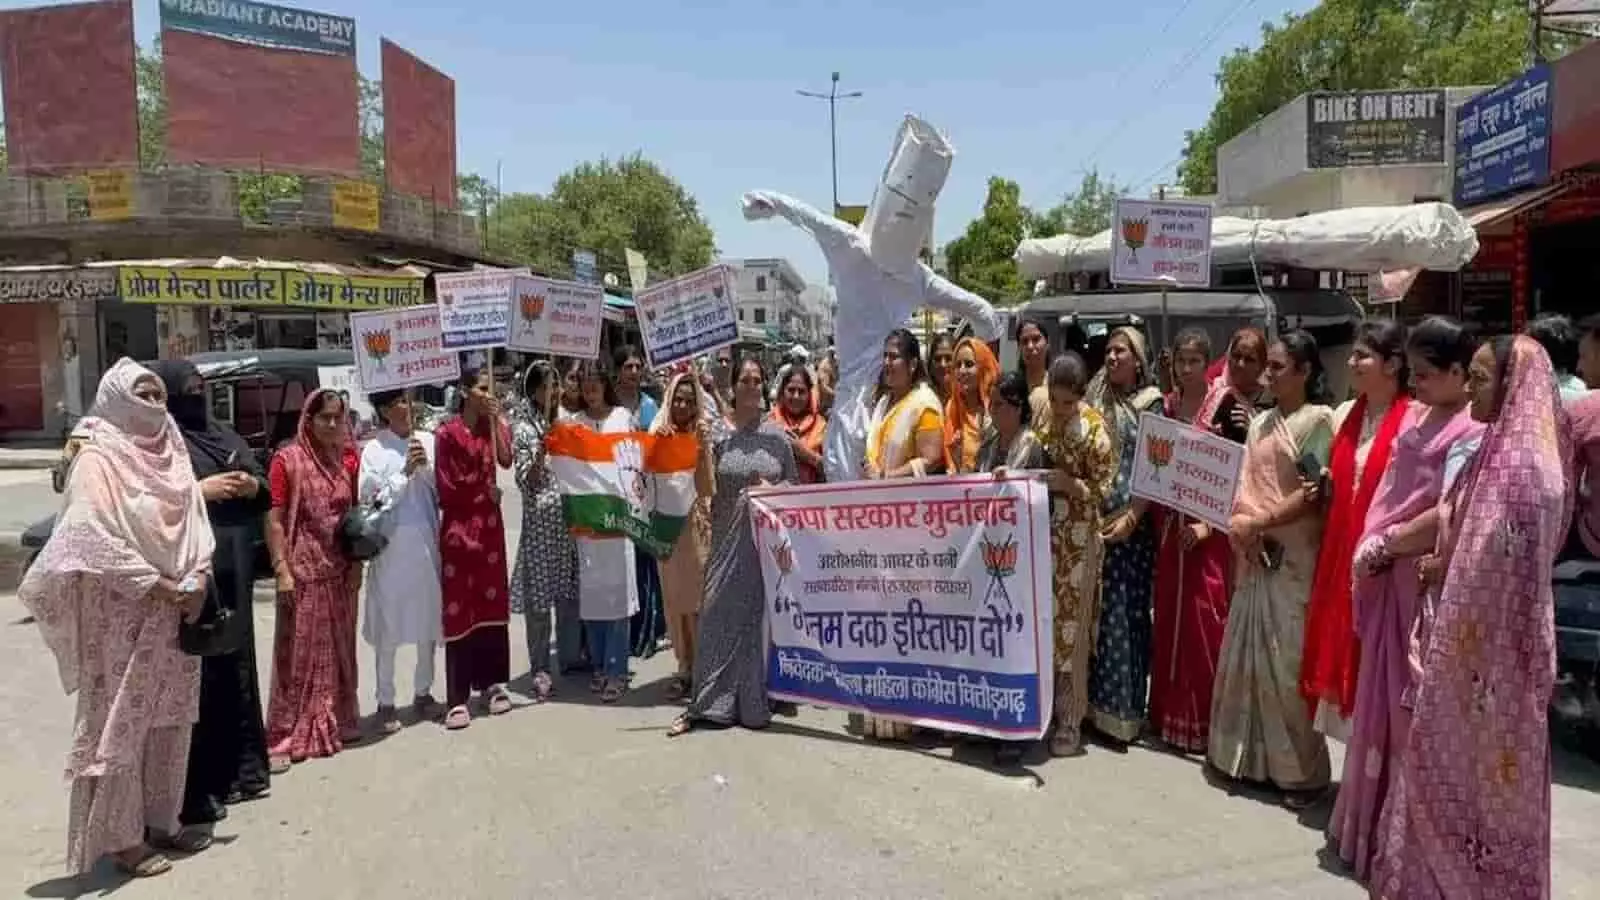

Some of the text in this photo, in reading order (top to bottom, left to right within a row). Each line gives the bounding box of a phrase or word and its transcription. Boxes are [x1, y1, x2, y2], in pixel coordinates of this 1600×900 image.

[179, 0, 353, 40] RADIANT ACADEMY
[1314, 94, 1438, 122] BIKE ON RENT
[165, 271, 211, 299] मेन्स
[216, 271, 276, 301] पार्लर
[290, 272, 334, 304] ओम
[340, 279, 380, 304] मेन्स
[384, 279, 422, 306] पार्लर
[830, 502, 918, 531] सरकार
[923, 488, 1019, 537] मुर्दाबाद
[847, 610, 889, 650] दक
[891, 597, 977, 658] इस्तिफा
[865, 667, 909, 701] महिला
[912, 668, 956, 705] कांग्रेस
